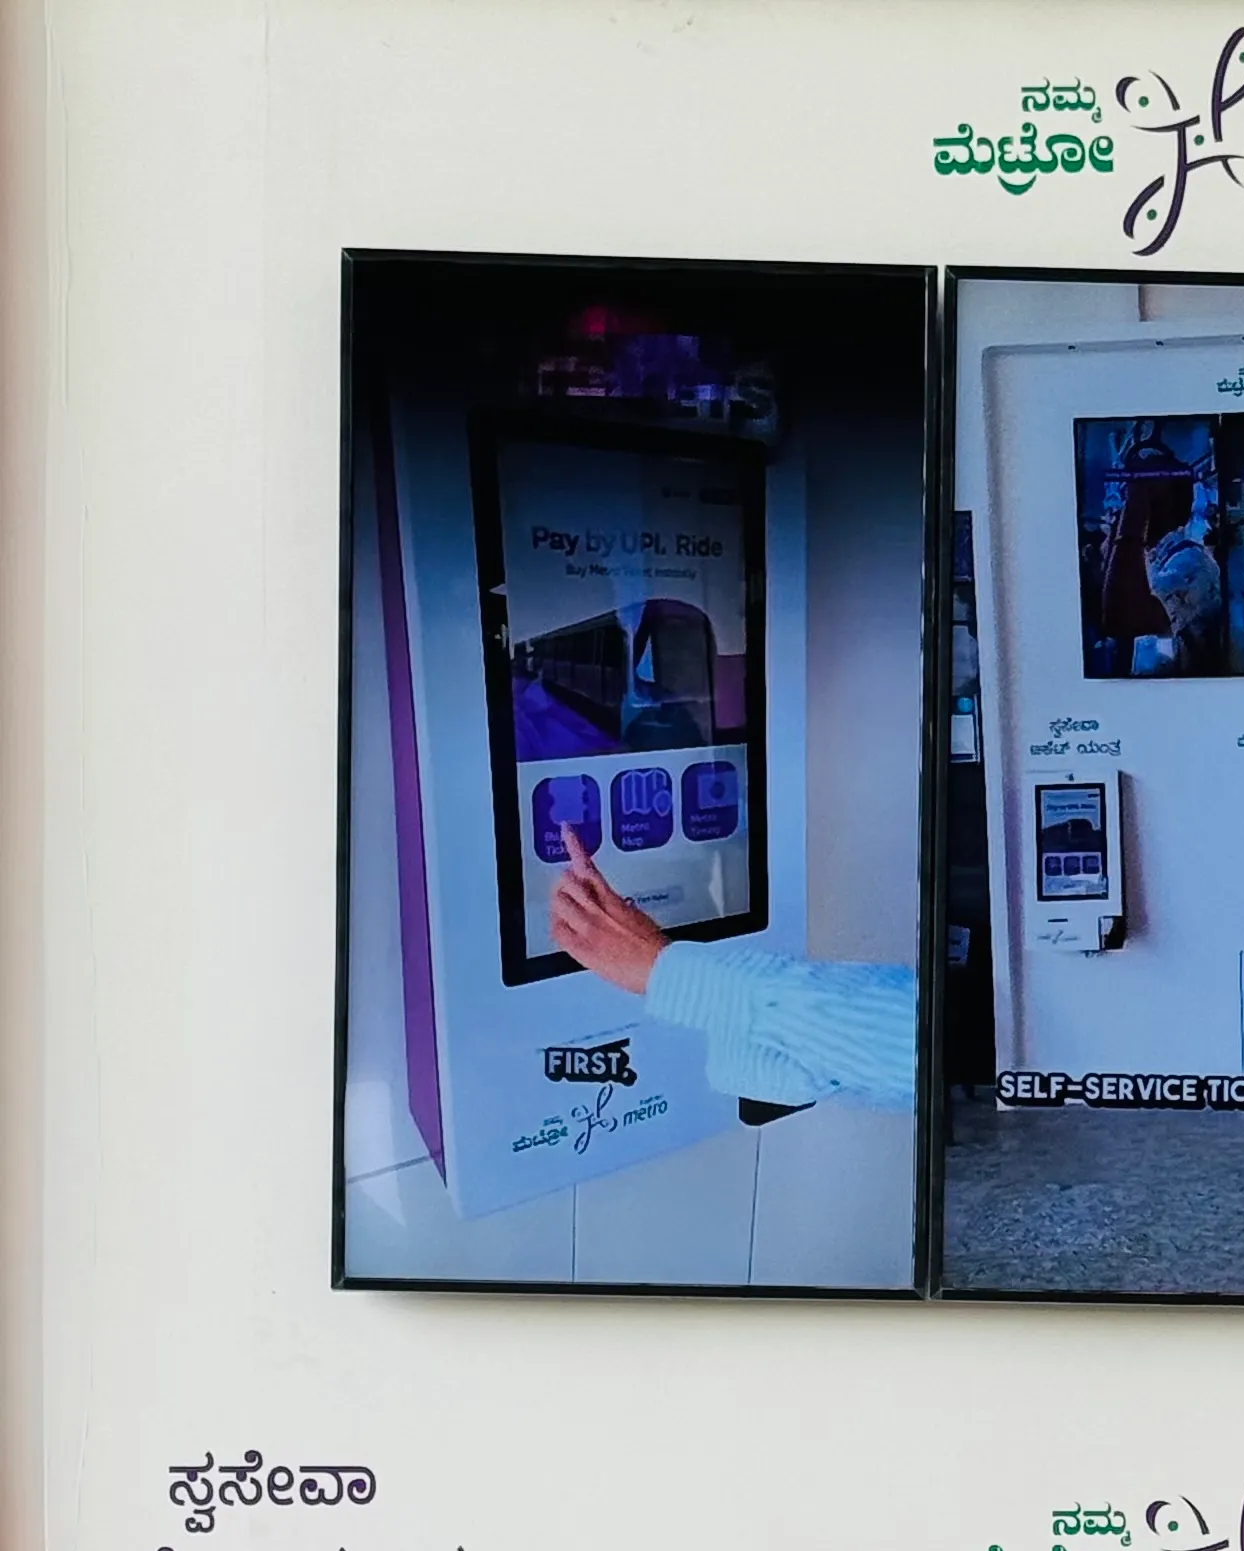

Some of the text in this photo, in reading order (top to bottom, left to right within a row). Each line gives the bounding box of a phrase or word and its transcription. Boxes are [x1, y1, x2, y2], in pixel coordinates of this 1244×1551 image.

[1021, 76, 1102, 123] ನಮ್ಮ
[933, 123, 1114, 195] ಮೆಟ್ರೋ
[531, 525, 580, 556] Pay
[586, 527, 617, 558] by
[676, 533, 724, 557] Ride
[548, 1051, 630, 1079] FIRST.
[999, 1073, 1198, 1101] SELF-SERVICE
[168, 1449, 376, 1533] ಸ್ವಸೇವಾ
[1052, 1501, 1131, 1547] ನಮ್ಮ
